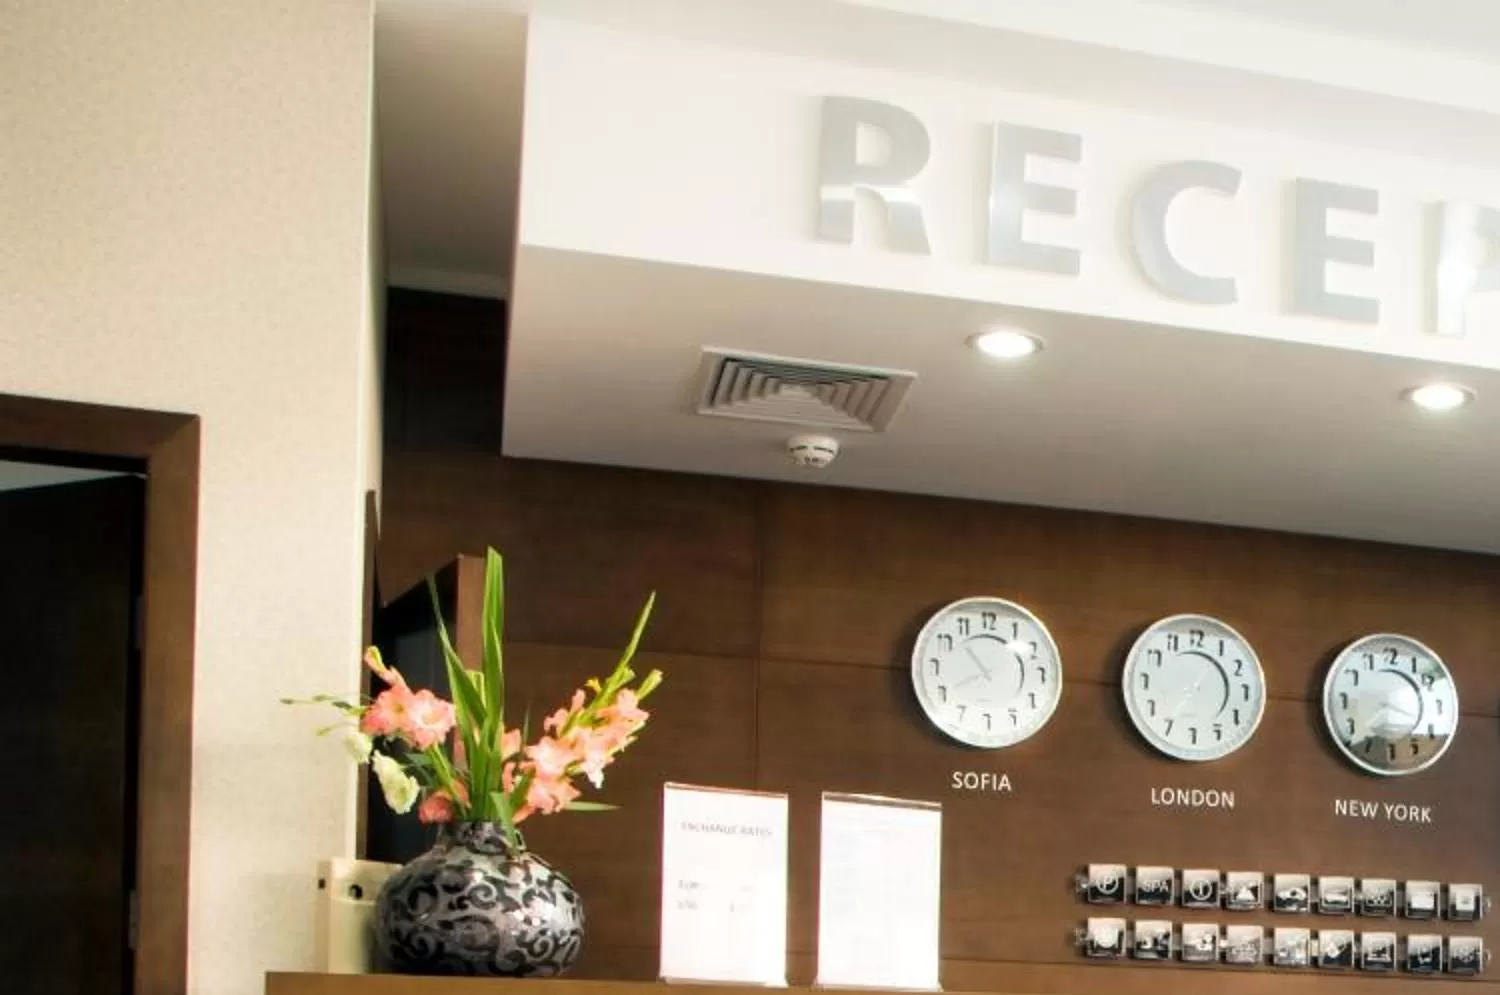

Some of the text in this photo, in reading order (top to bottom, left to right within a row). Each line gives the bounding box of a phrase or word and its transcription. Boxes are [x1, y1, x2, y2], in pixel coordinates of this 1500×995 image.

[952, 771, 1012, 791] SOFIA
[1151, 787, 1235, 808] LONDON
[1335, 799, 1432, 823] NEW YORK
[1142, 879, 1169, 893] SPA
